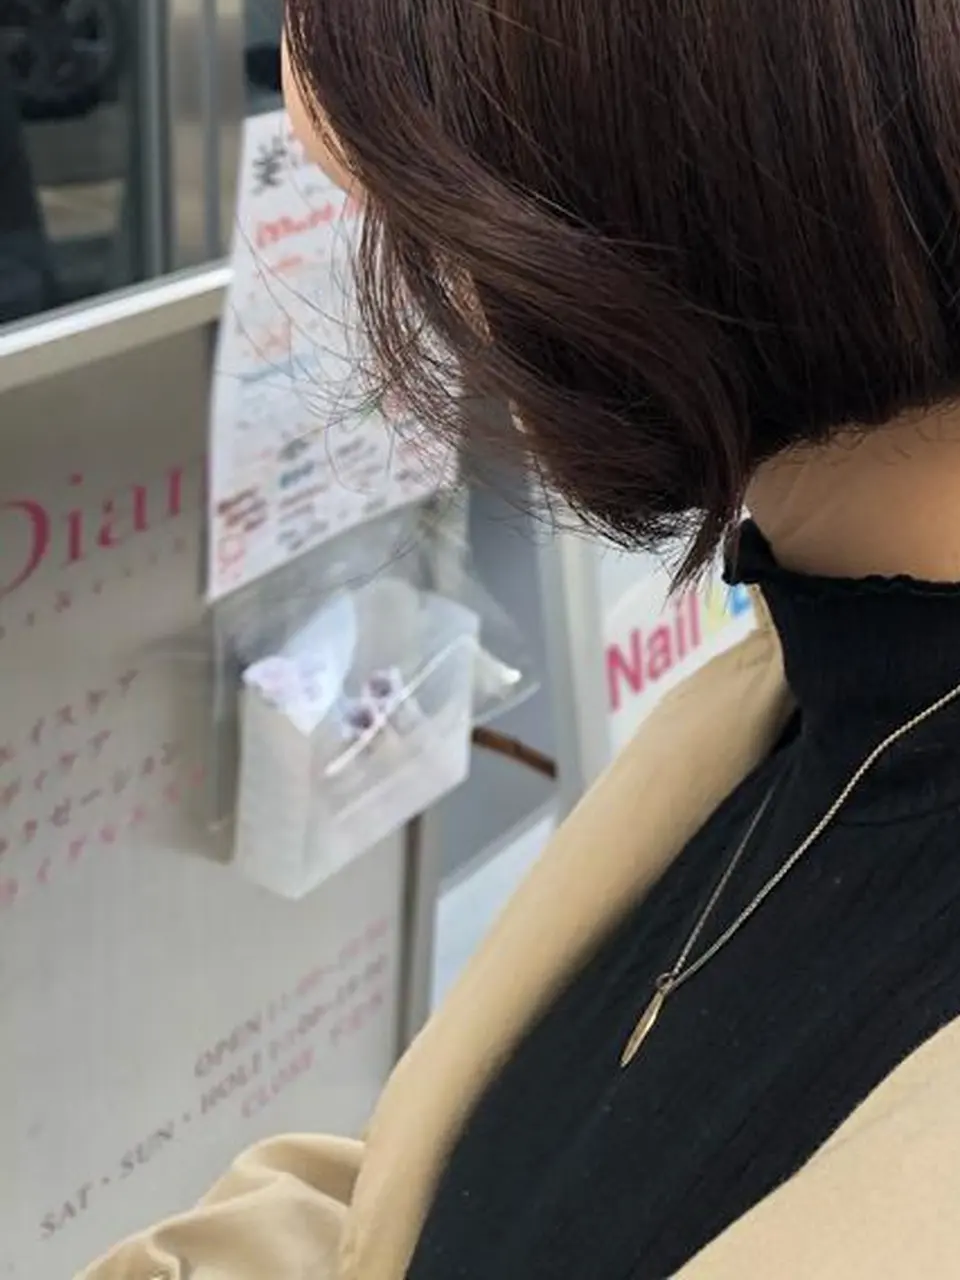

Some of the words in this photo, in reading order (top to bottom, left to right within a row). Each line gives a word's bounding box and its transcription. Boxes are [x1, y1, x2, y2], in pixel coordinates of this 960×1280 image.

[604, 584, 704, 714] Nail
[194, 1008, 264, 1078] OPEN
[37, 1180, 93, 1242] SAT
[118, 1119, 176, 1181] SUN
